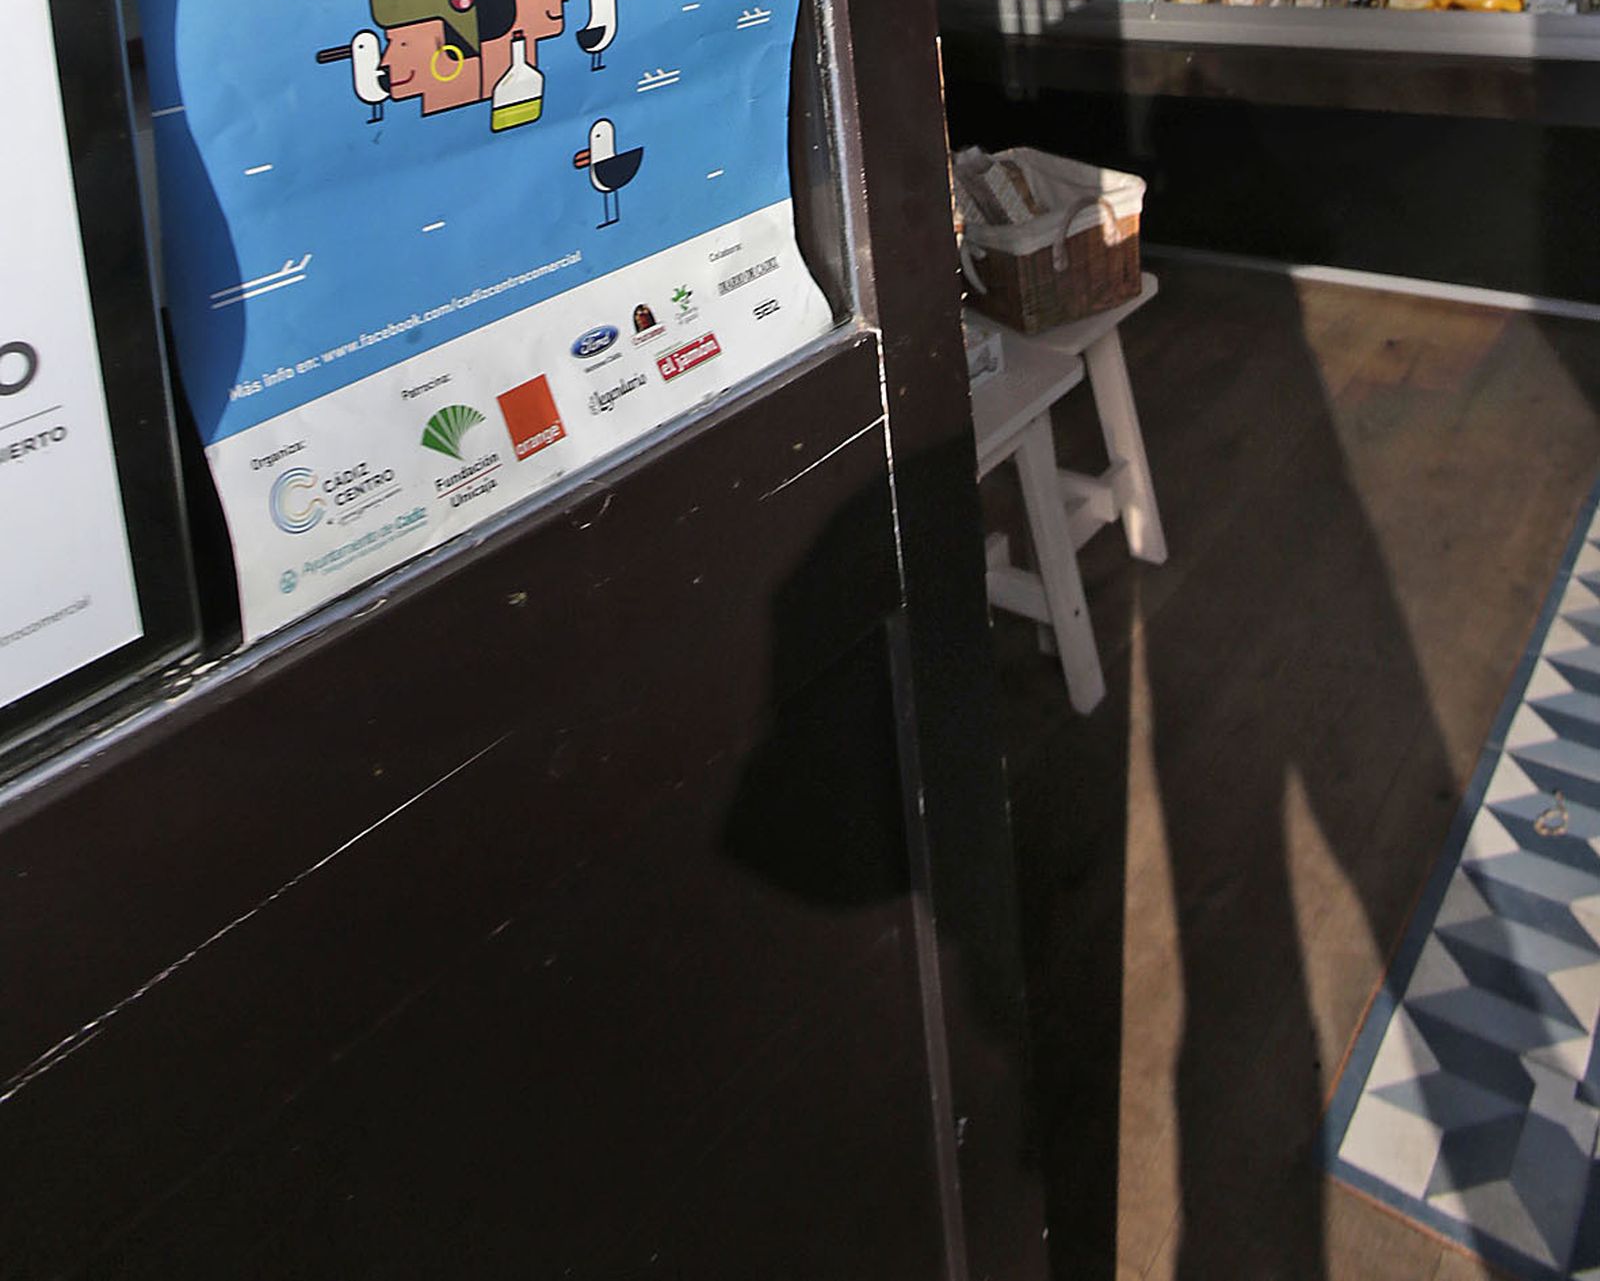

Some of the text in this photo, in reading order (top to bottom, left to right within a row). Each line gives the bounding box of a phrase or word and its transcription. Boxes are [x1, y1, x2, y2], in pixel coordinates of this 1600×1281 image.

[263, 365, 294, 388] info
[516, 422, 562, 458] orange
[322, 461, 371, 494] CÁDIZ
[333, 468, 396, 507] CENTRO
[434, 451, 501, 493] Fundación
[450, 476, 498, 509] Unicaja
